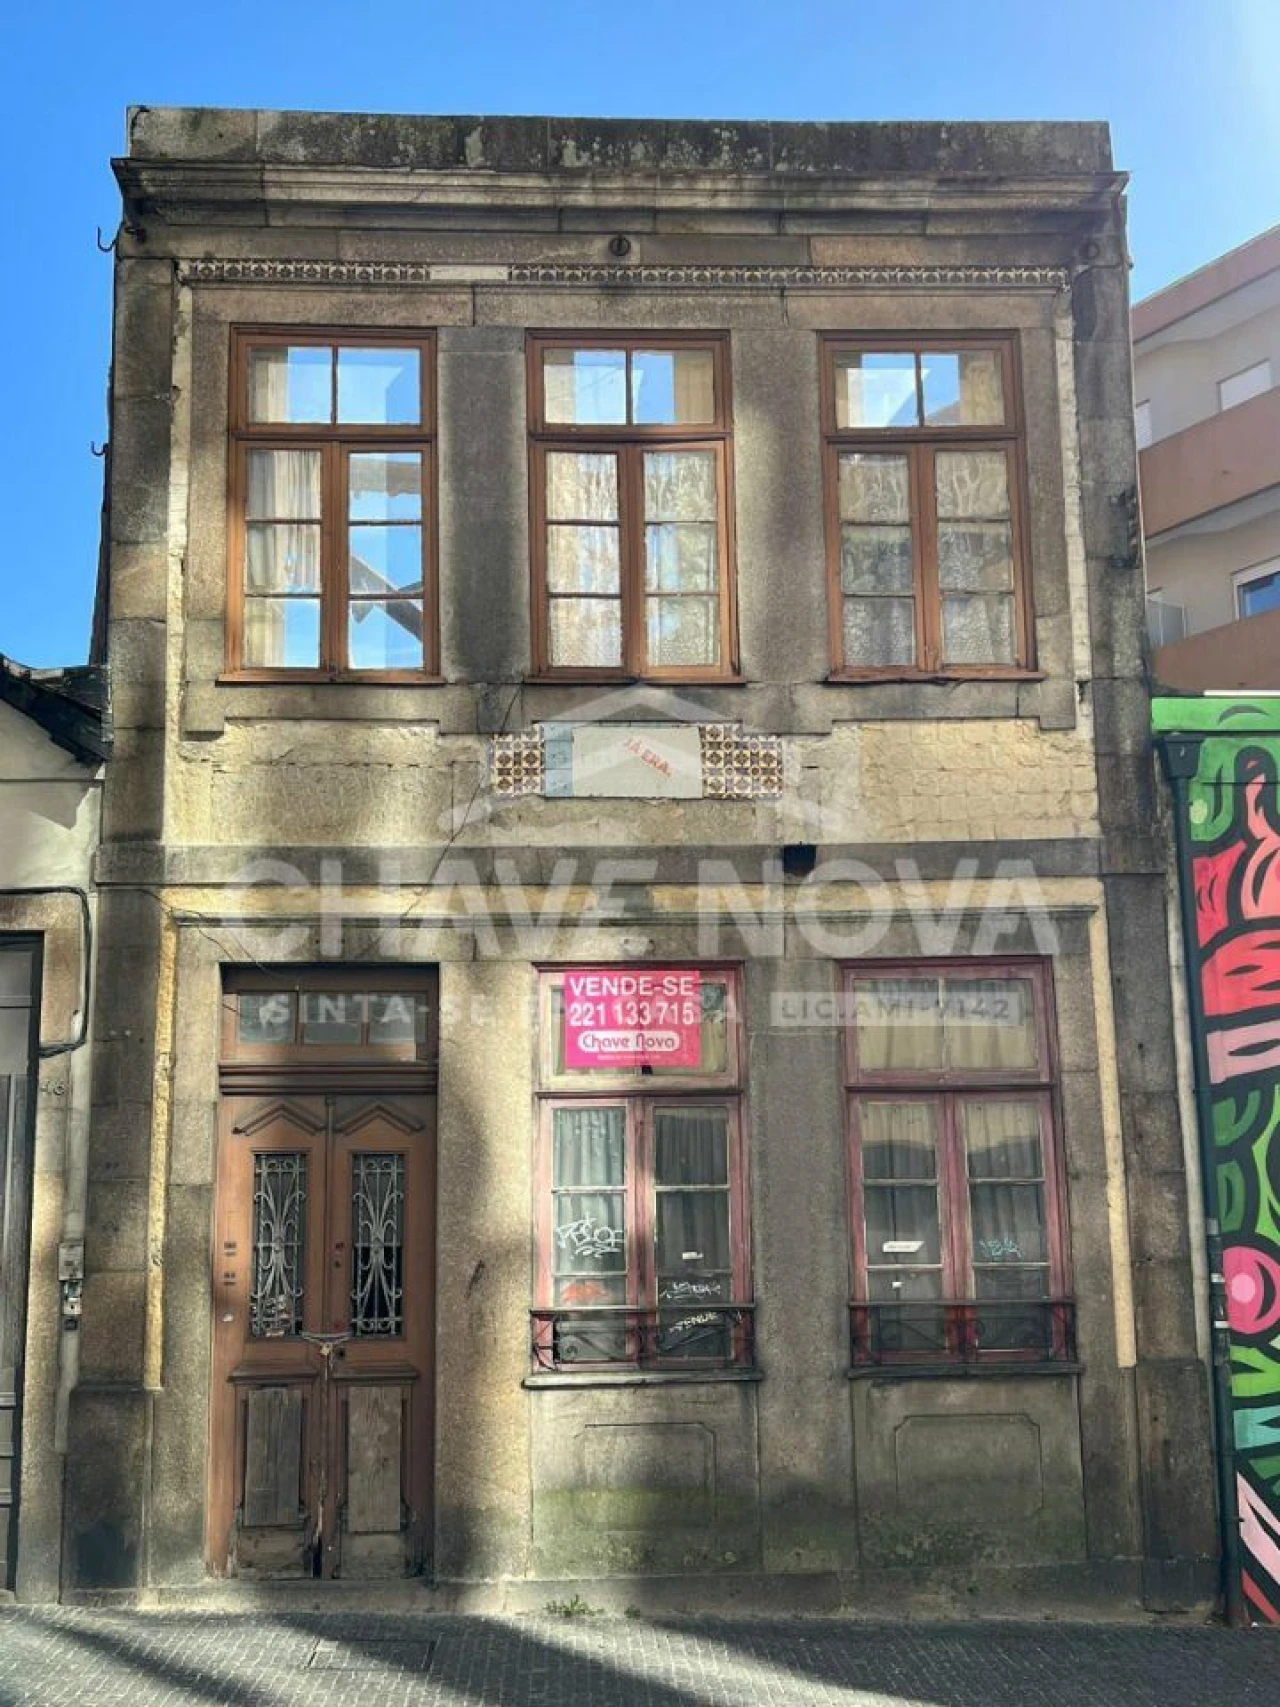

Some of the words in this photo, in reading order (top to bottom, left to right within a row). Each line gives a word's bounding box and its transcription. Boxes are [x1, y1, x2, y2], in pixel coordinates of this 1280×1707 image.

[569, 975, 694, 997] VENDE-SE
[569, 1002, 607, 1027] 221
[612, 1002, 652, 1026] 133
[655, 1002, 695, 1026] 715
[582, 1033, 631, 1050] Chave
